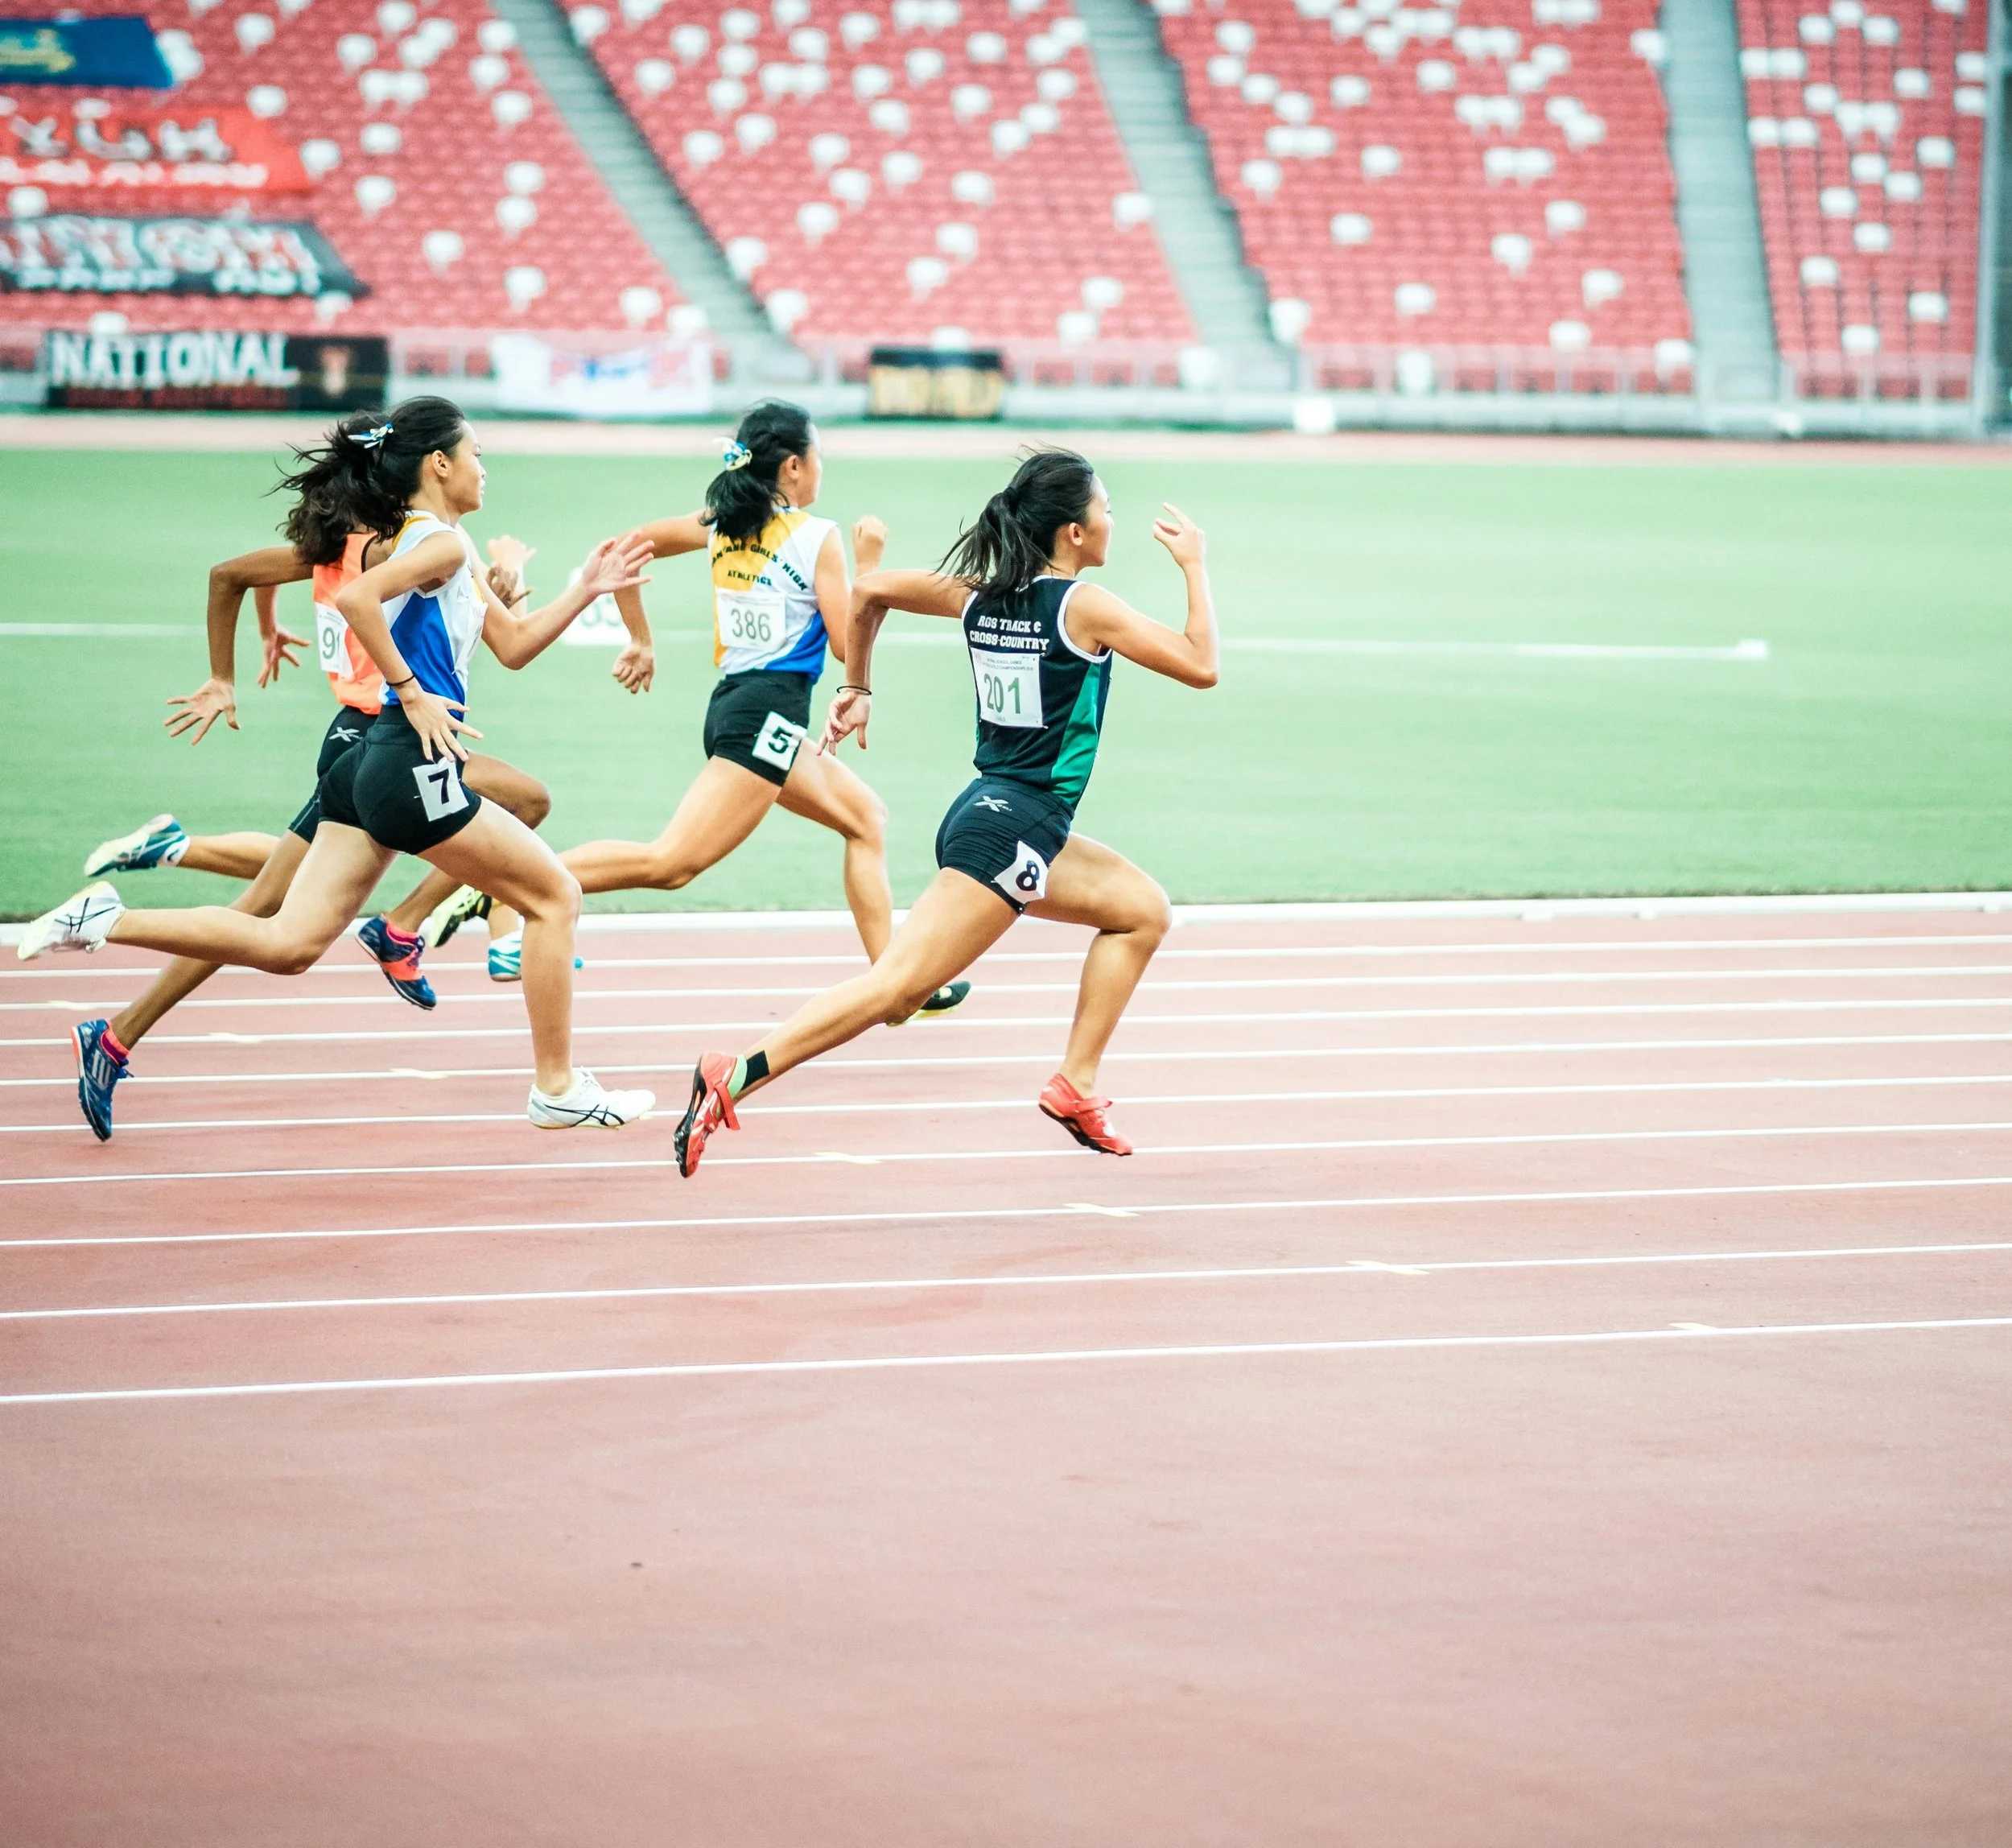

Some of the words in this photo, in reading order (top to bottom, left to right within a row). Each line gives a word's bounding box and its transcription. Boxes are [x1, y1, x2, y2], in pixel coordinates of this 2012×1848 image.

[52, 331, 300, 389] NATIONAL
[728, 570, 772, 587] ATHLETICS
[730, 608, 771, 641] 386
[970, 630, 1050, 650] CROSS-COUNTRY
[977, 615, 998, 629] RGS
[1000, 618, 1032, 633] TRACK
[983, 673, 1021, 714] 201
[768, 727, 792, 753] 5
[428, 769, 450, 805] 7
[1016, 860, 1040, 892] 8
